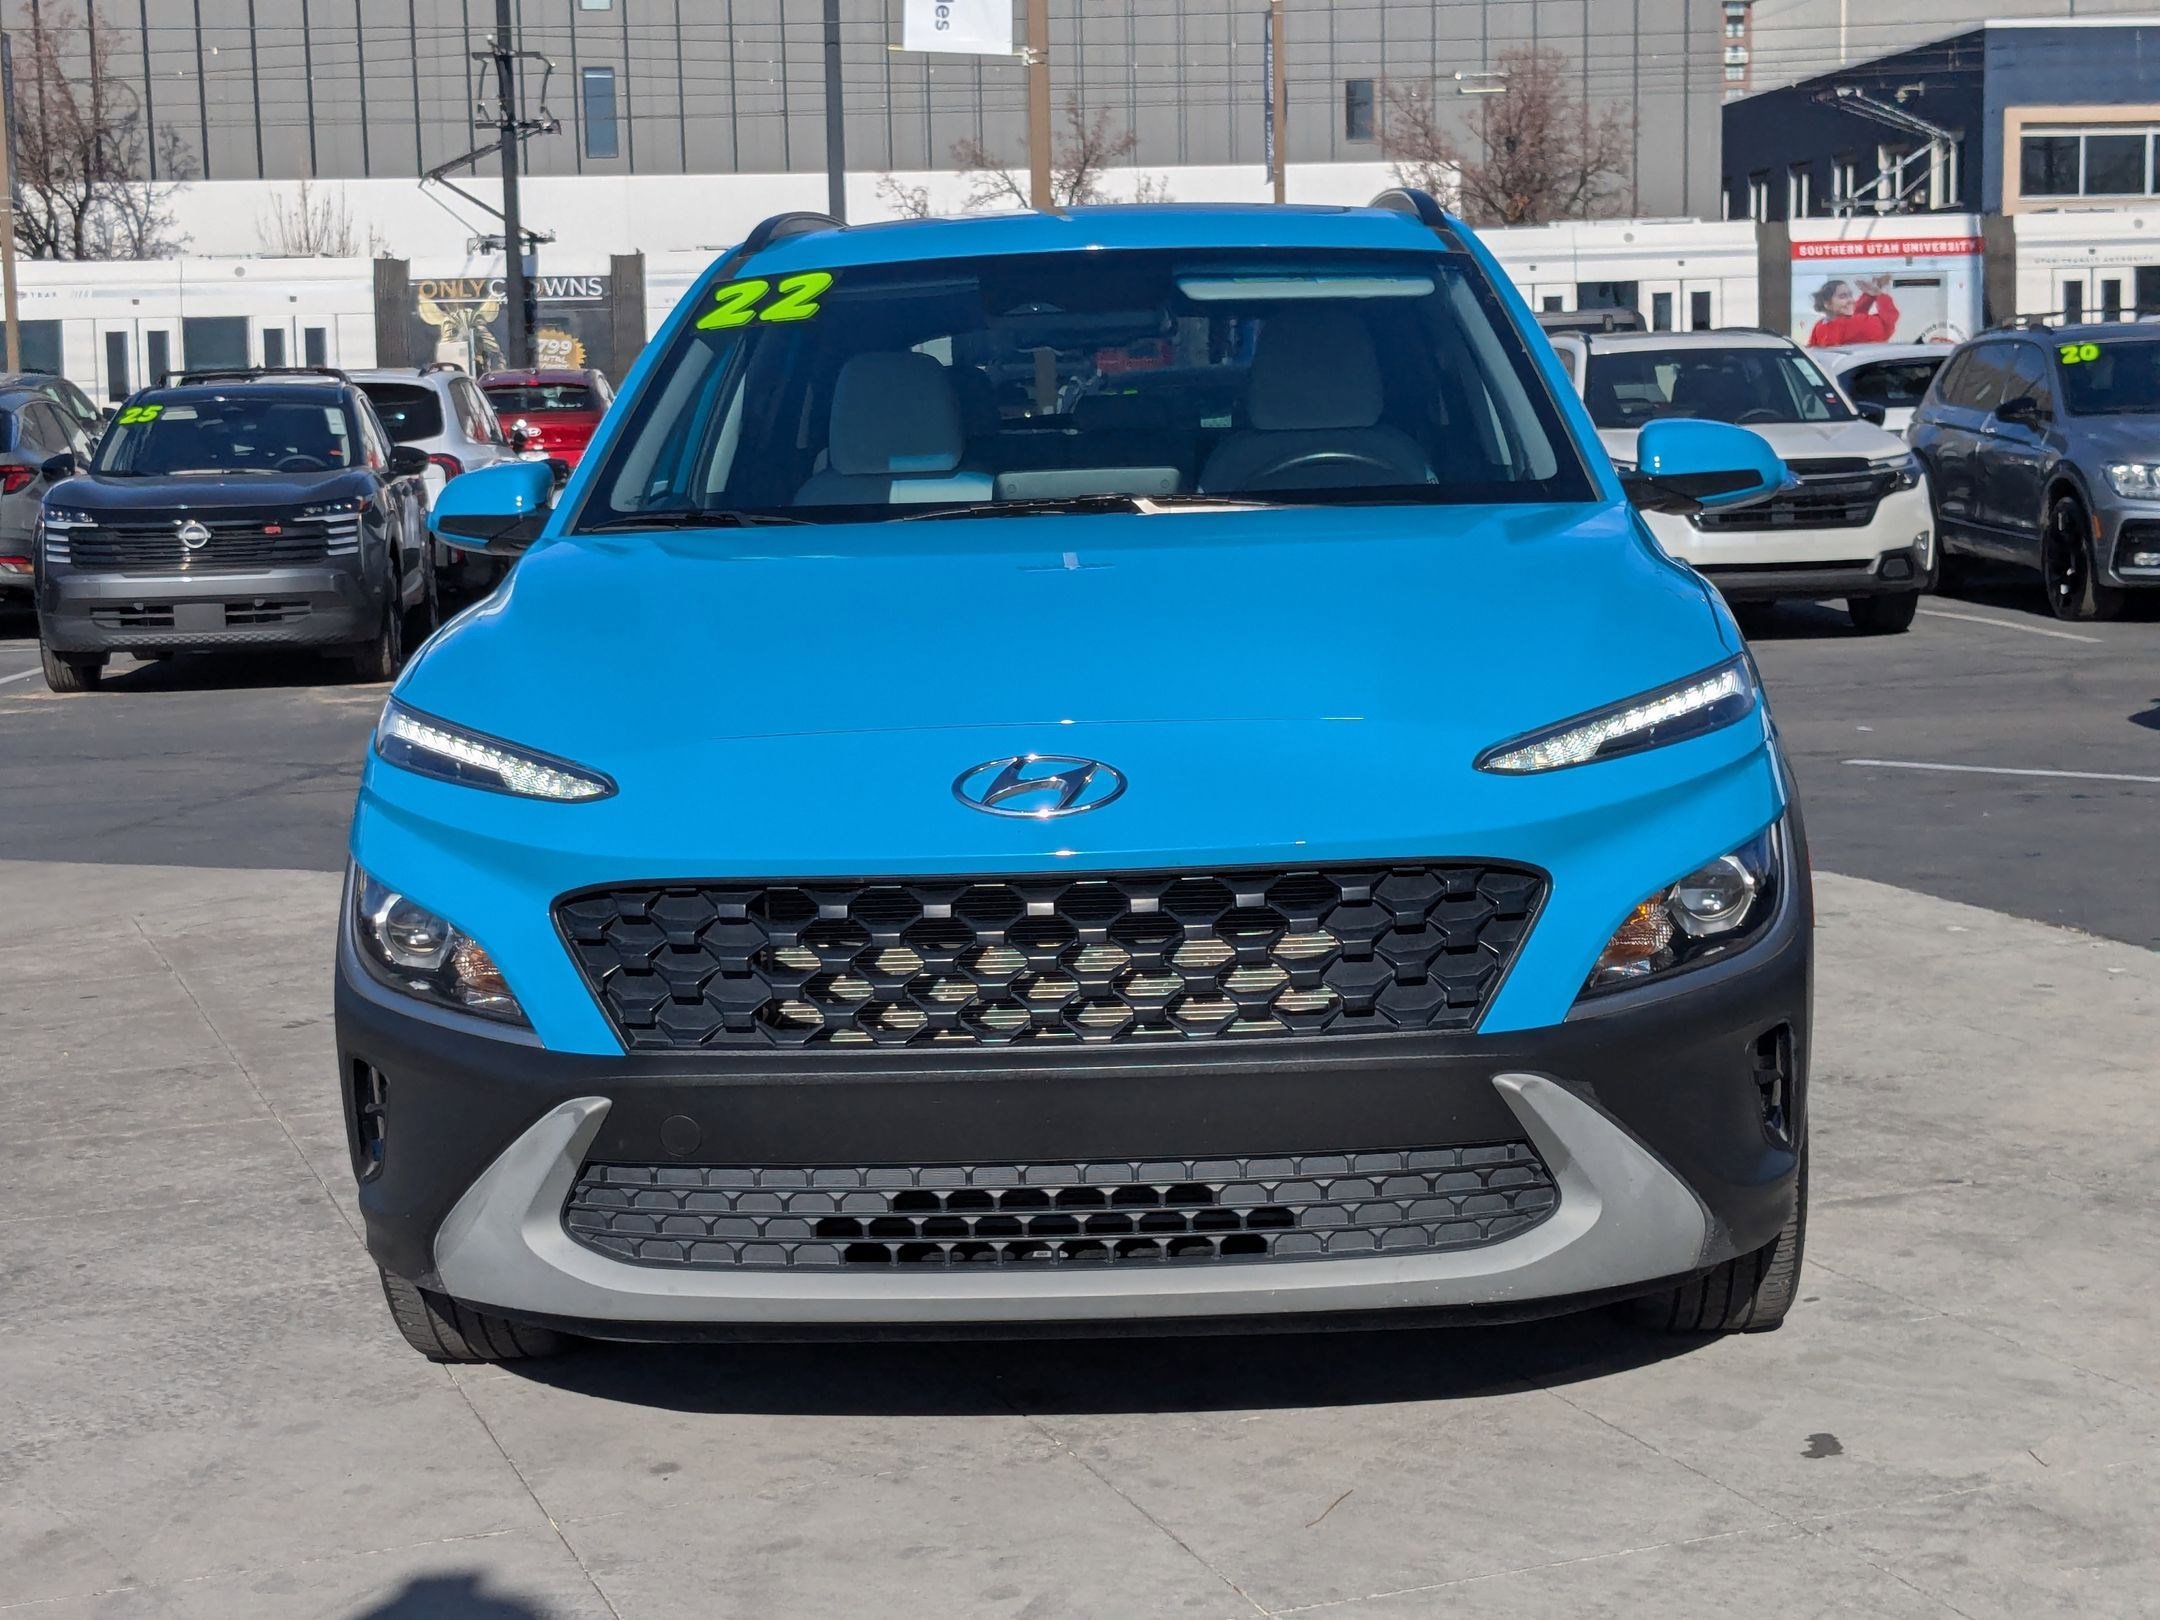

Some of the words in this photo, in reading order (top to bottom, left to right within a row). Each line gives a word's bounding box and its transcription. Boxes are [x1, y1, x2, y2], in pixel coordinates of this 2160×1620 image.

[1799, 244, 1865, 257] SOUTHERN
[1867, 243, 1899, 254] UTAH
[1902, 240, 1977, 253] UNIVERSITY
[419, 279, 485, 298] ONLY
[489, 277, 603, 297] CWNS
[696, 272, 833, 330] 22
[2060, 343, 2099, 364] 20
[119, 404, 163, 424] 25
